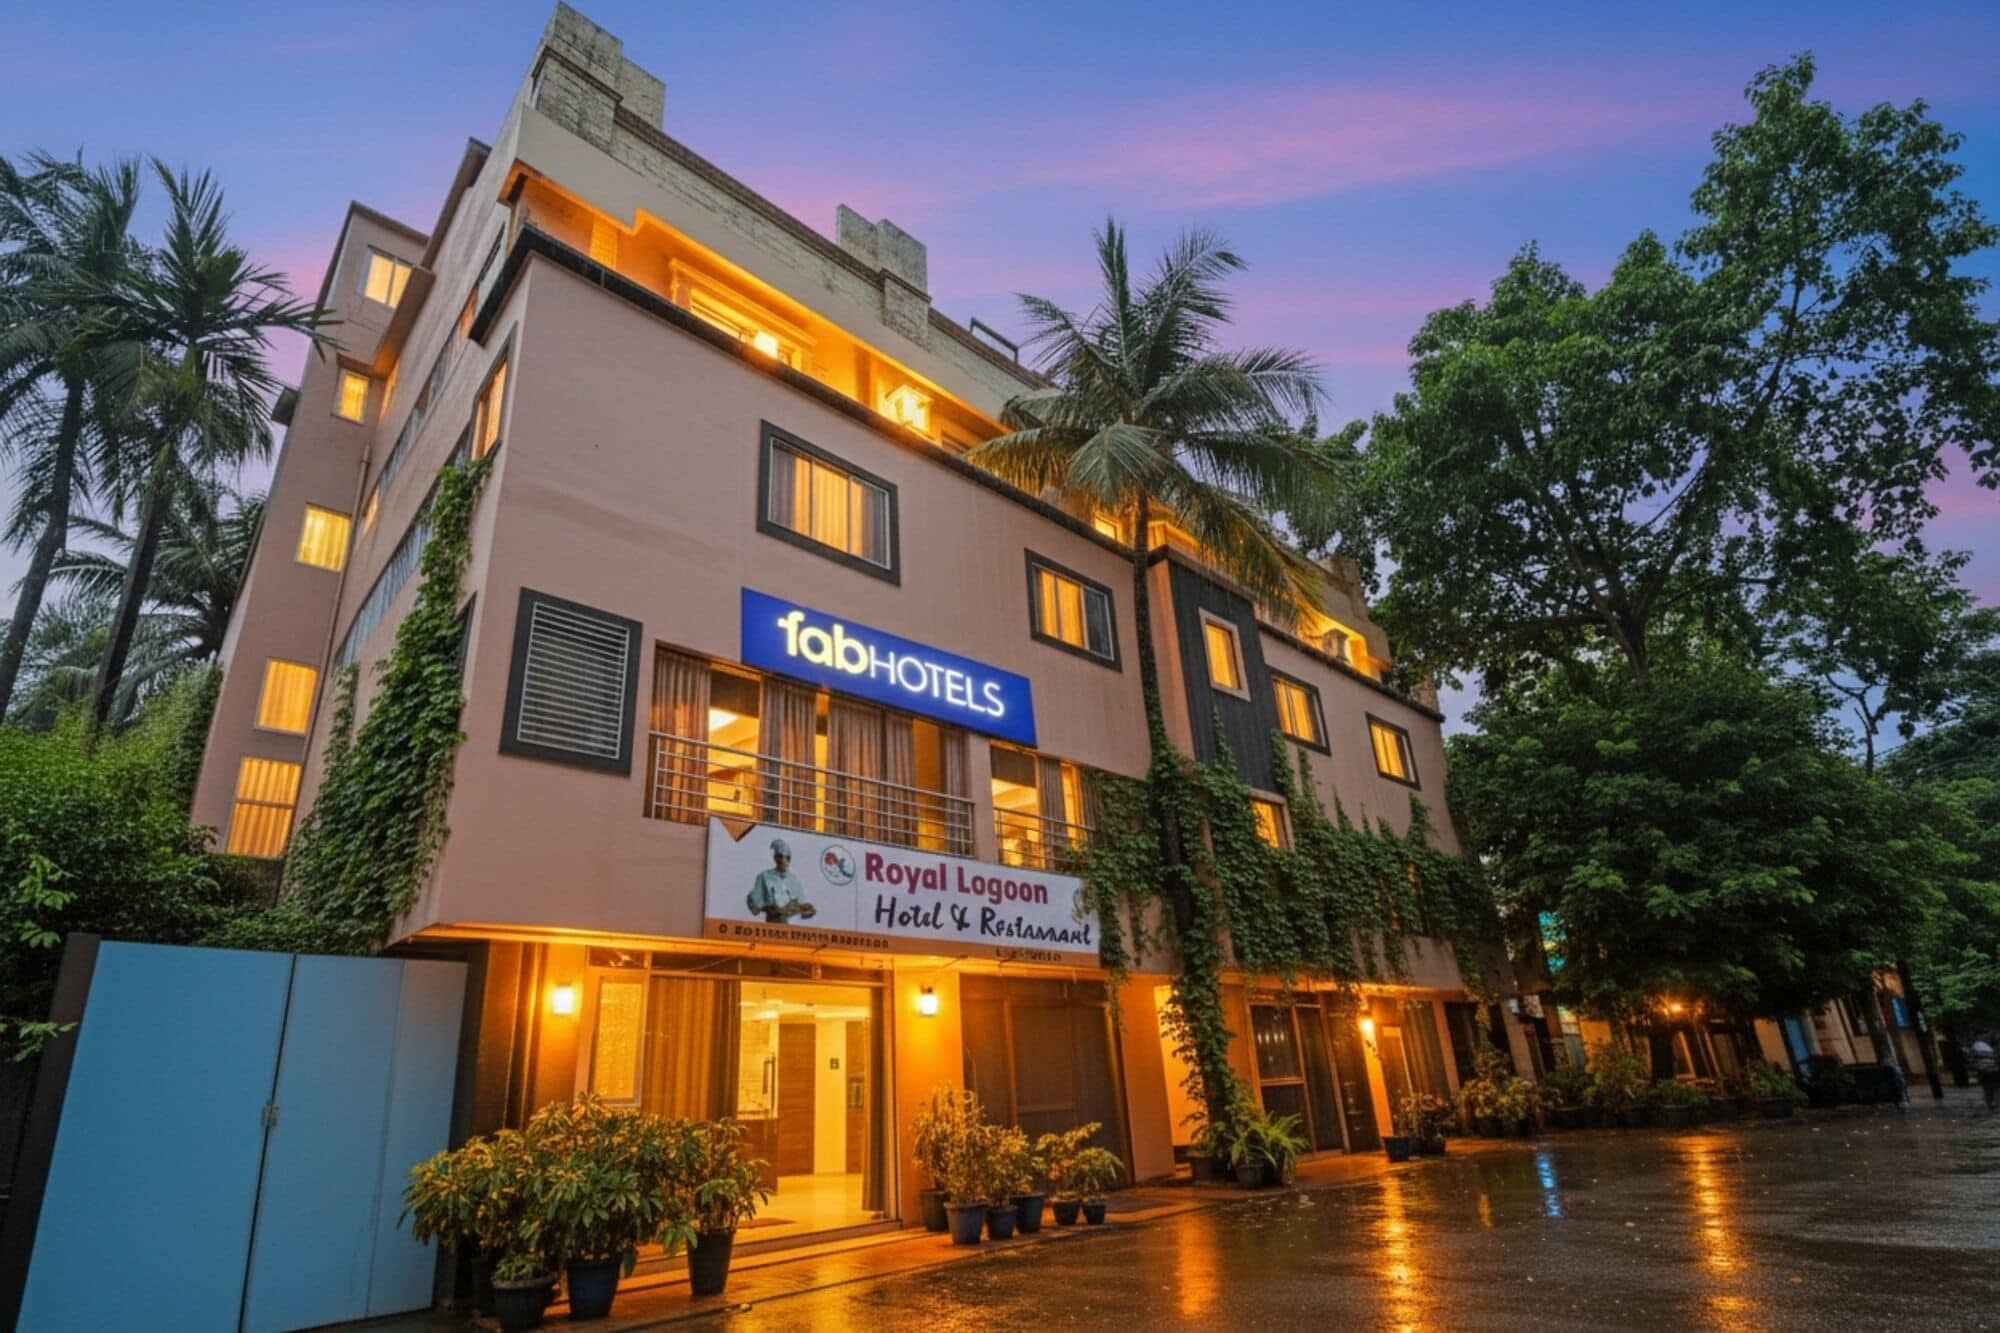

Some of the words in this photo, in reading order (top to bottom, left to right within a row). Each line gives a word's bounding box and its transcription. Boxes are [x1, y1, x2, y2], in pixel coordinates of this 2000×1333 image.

[777, 610, 1005, 717] fabHOTELS
[865, 852, 947, 894] Royal
[957, 866, 1048, 905] Logoon
[875, 894, 944, 930] Hotel
[951, 904, 970, 931] &
